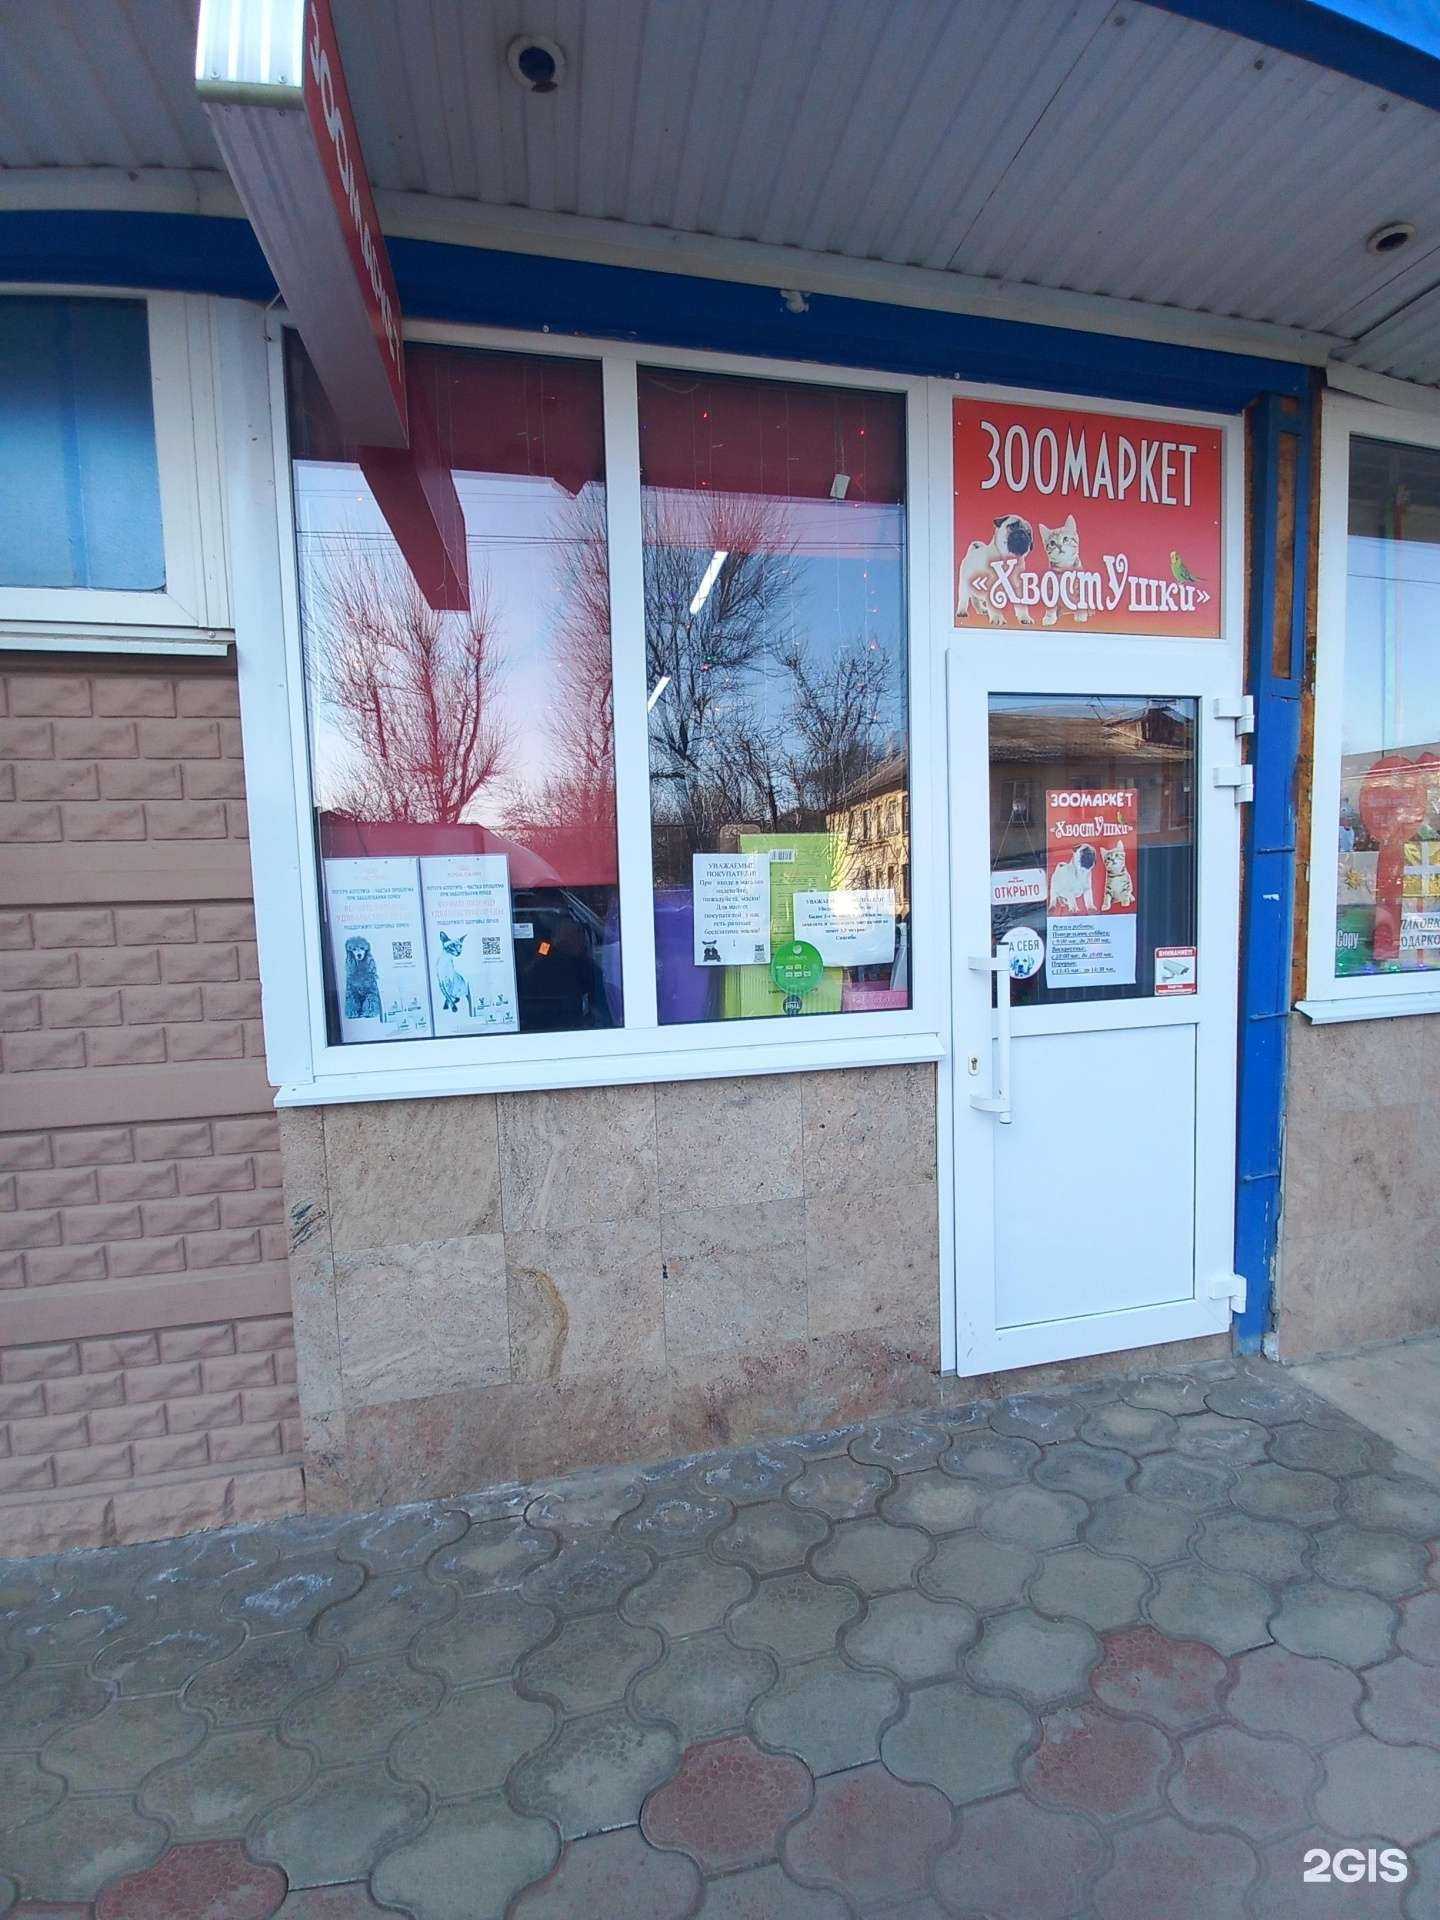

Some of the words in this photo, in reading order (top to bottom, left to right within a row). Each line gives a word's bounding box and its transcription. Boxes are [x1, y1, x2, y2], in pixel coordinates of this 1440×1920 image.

[979, 419, 1197, 507] ЗООМАРКЕТ
[1050, 792, 1133, 808] ЗООМАРКЕТ
[994, 884, 1040, 899] ОТКРЫТО
[1017, 939, 1040, 952] СЕБЯ
